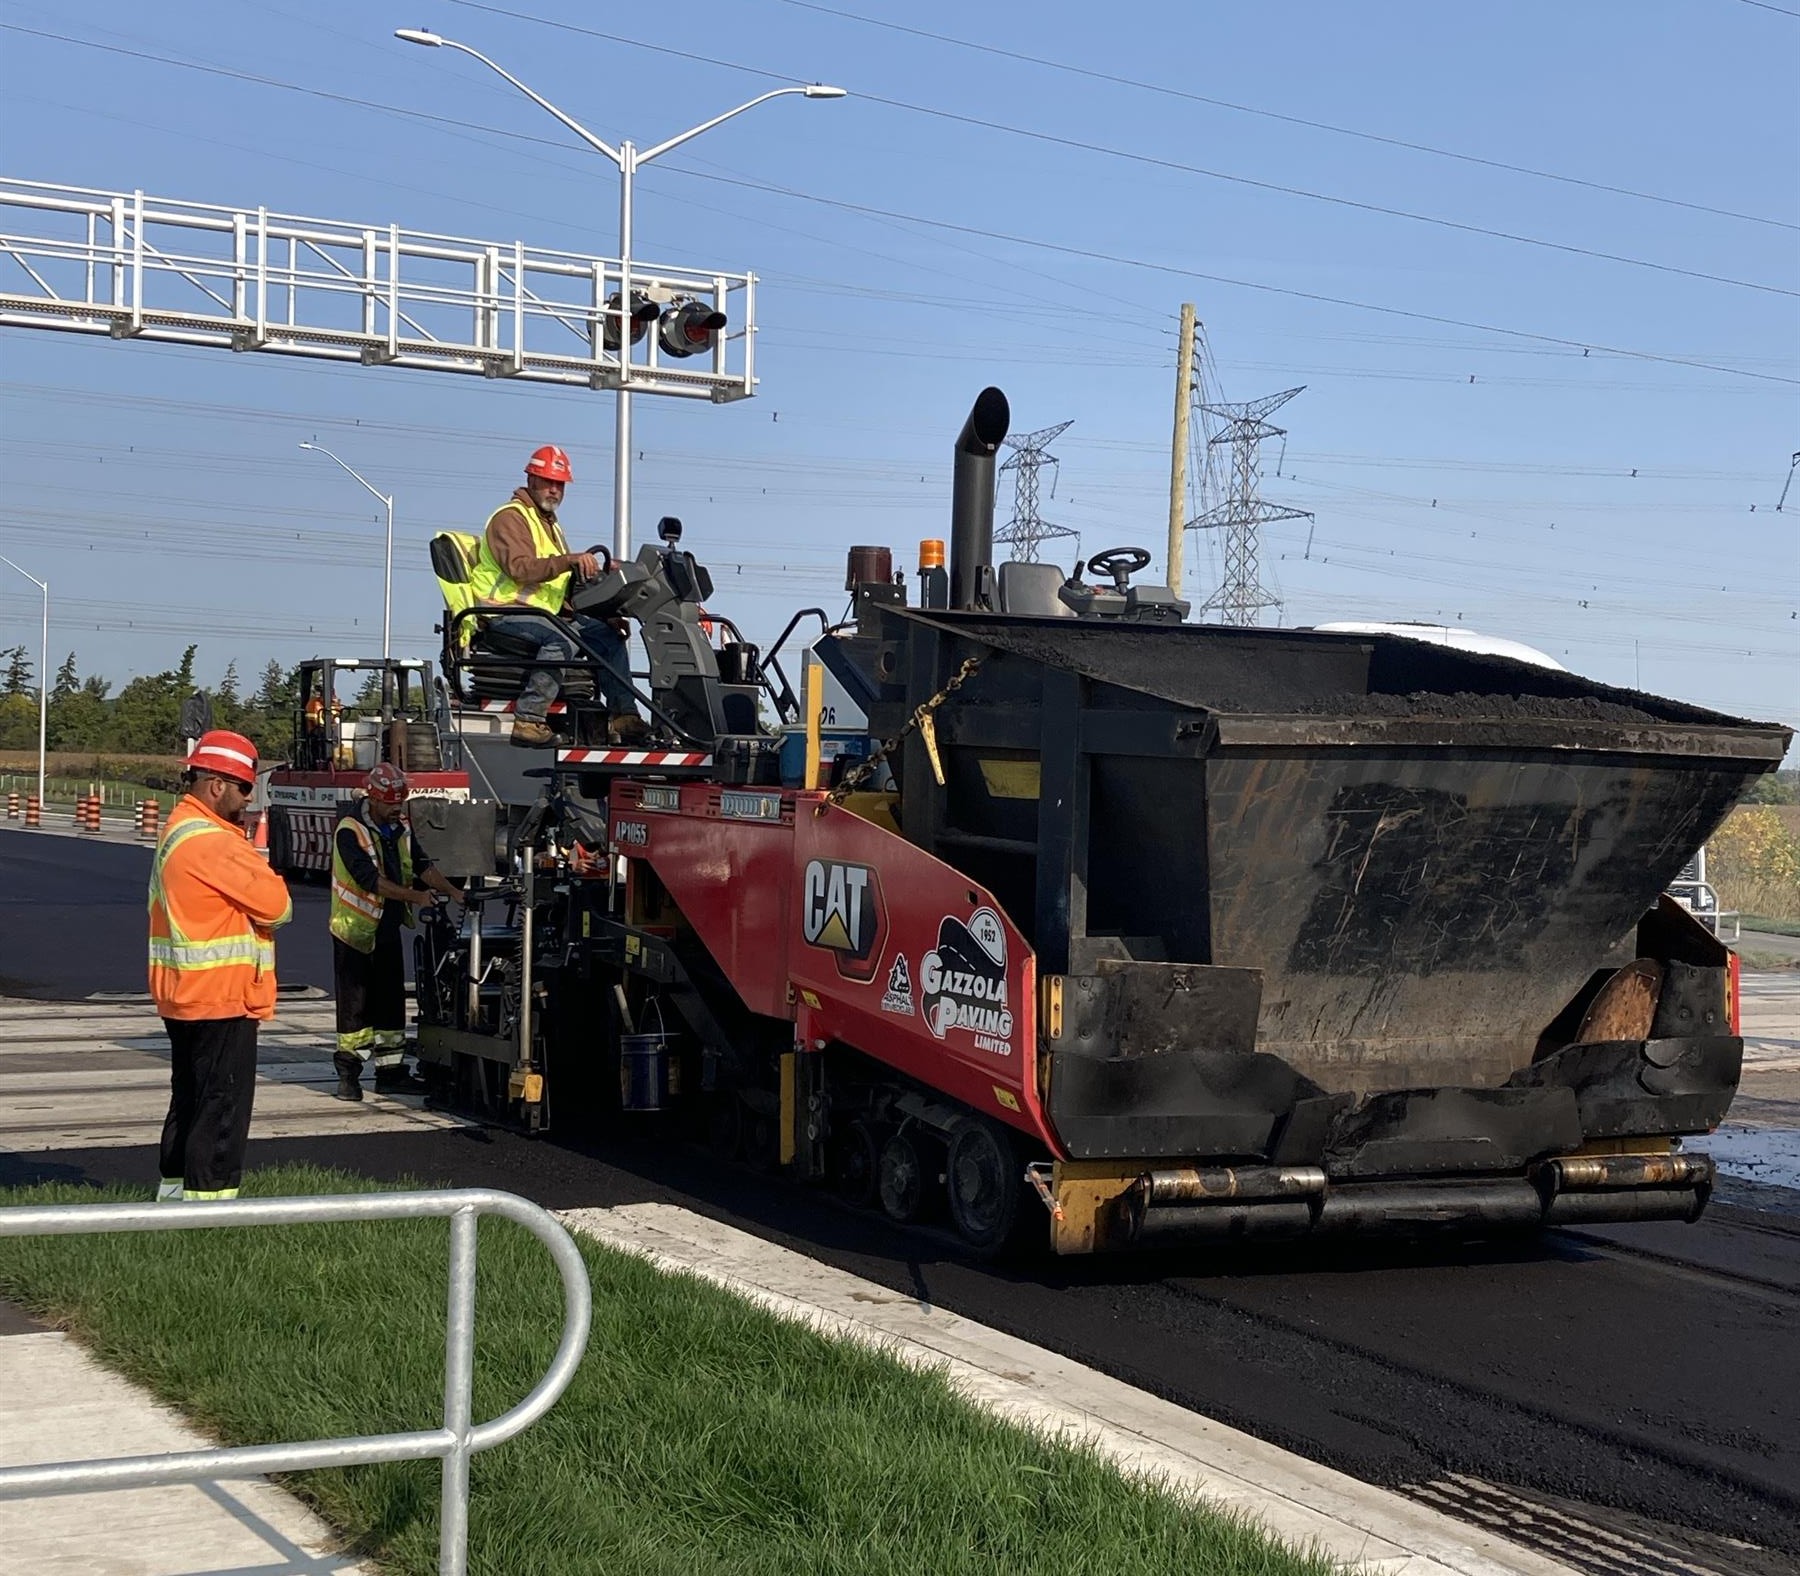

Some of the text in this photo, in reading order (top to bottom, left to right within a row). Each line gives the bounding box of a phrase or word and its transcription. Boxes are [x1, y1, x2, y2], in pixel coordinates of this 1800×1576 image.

[615, 820, 647, 845] AP1055
[804, 860, 868, 951] CAT
[980, 928, 996, 942] 1952
[922, 951, 1007, 1004] GAZZOLA
[935, 996, 1012, 1038] PAVING
[973, 1034, 1012, 1057] LIMITED
